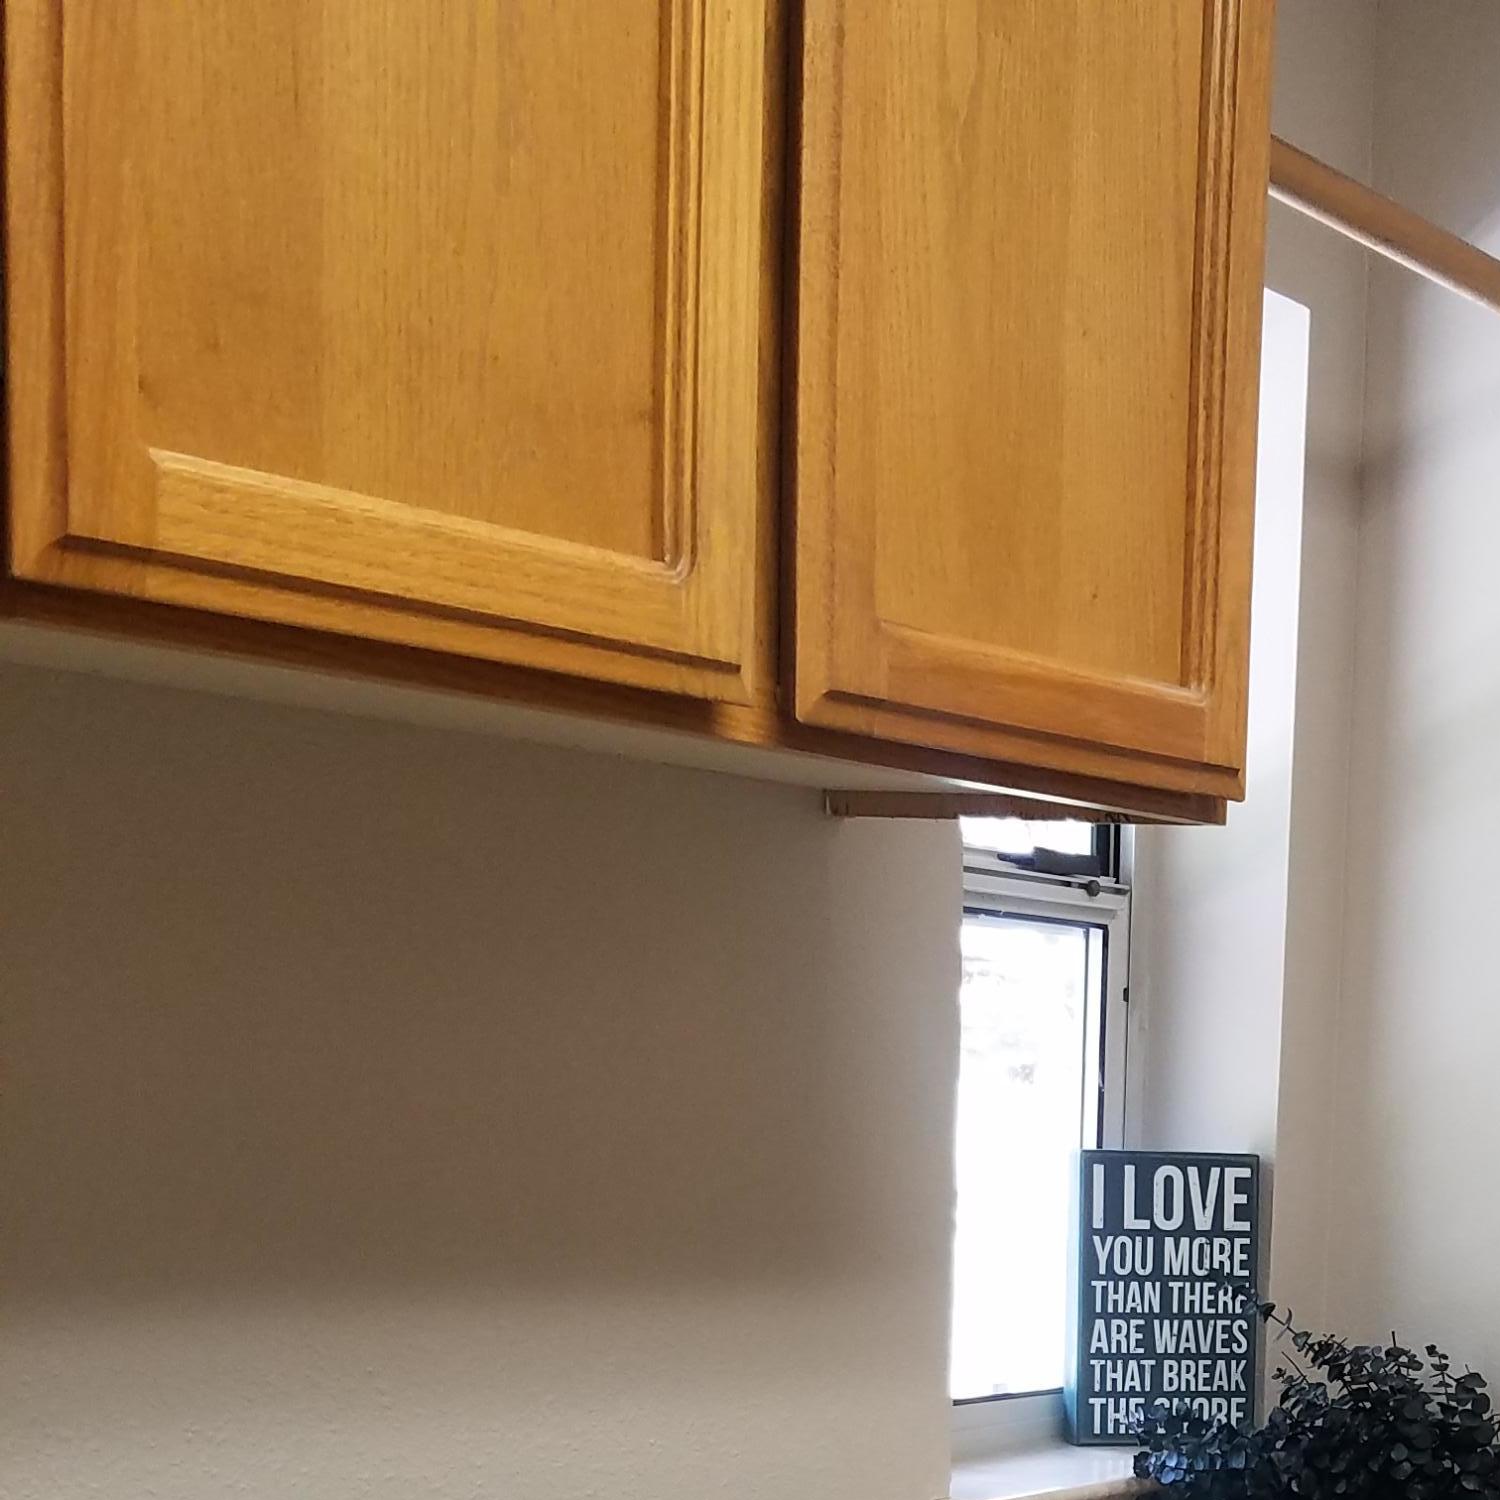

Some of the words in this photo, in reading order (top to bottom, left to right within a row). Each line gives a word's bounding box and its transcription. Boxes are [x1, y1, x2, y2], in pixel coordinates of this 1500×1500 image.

[1092, 1163, 1104, 1230] I
[1123, 1164, 1251, 1231] LOVE
[1092, 1235, 1154, 1276] YOU
[1163, 1236, 1251, 1277] MORE
[1091, 1281, 1160, 1314] THAN
[1090, 1319, 1145, 1354] ARE
[1154, 1319, 1248, 1354] WAVES
[1090, 1359, 1156, 1392] THAT
[1163, 1359, 1247, 1392] BREAK
